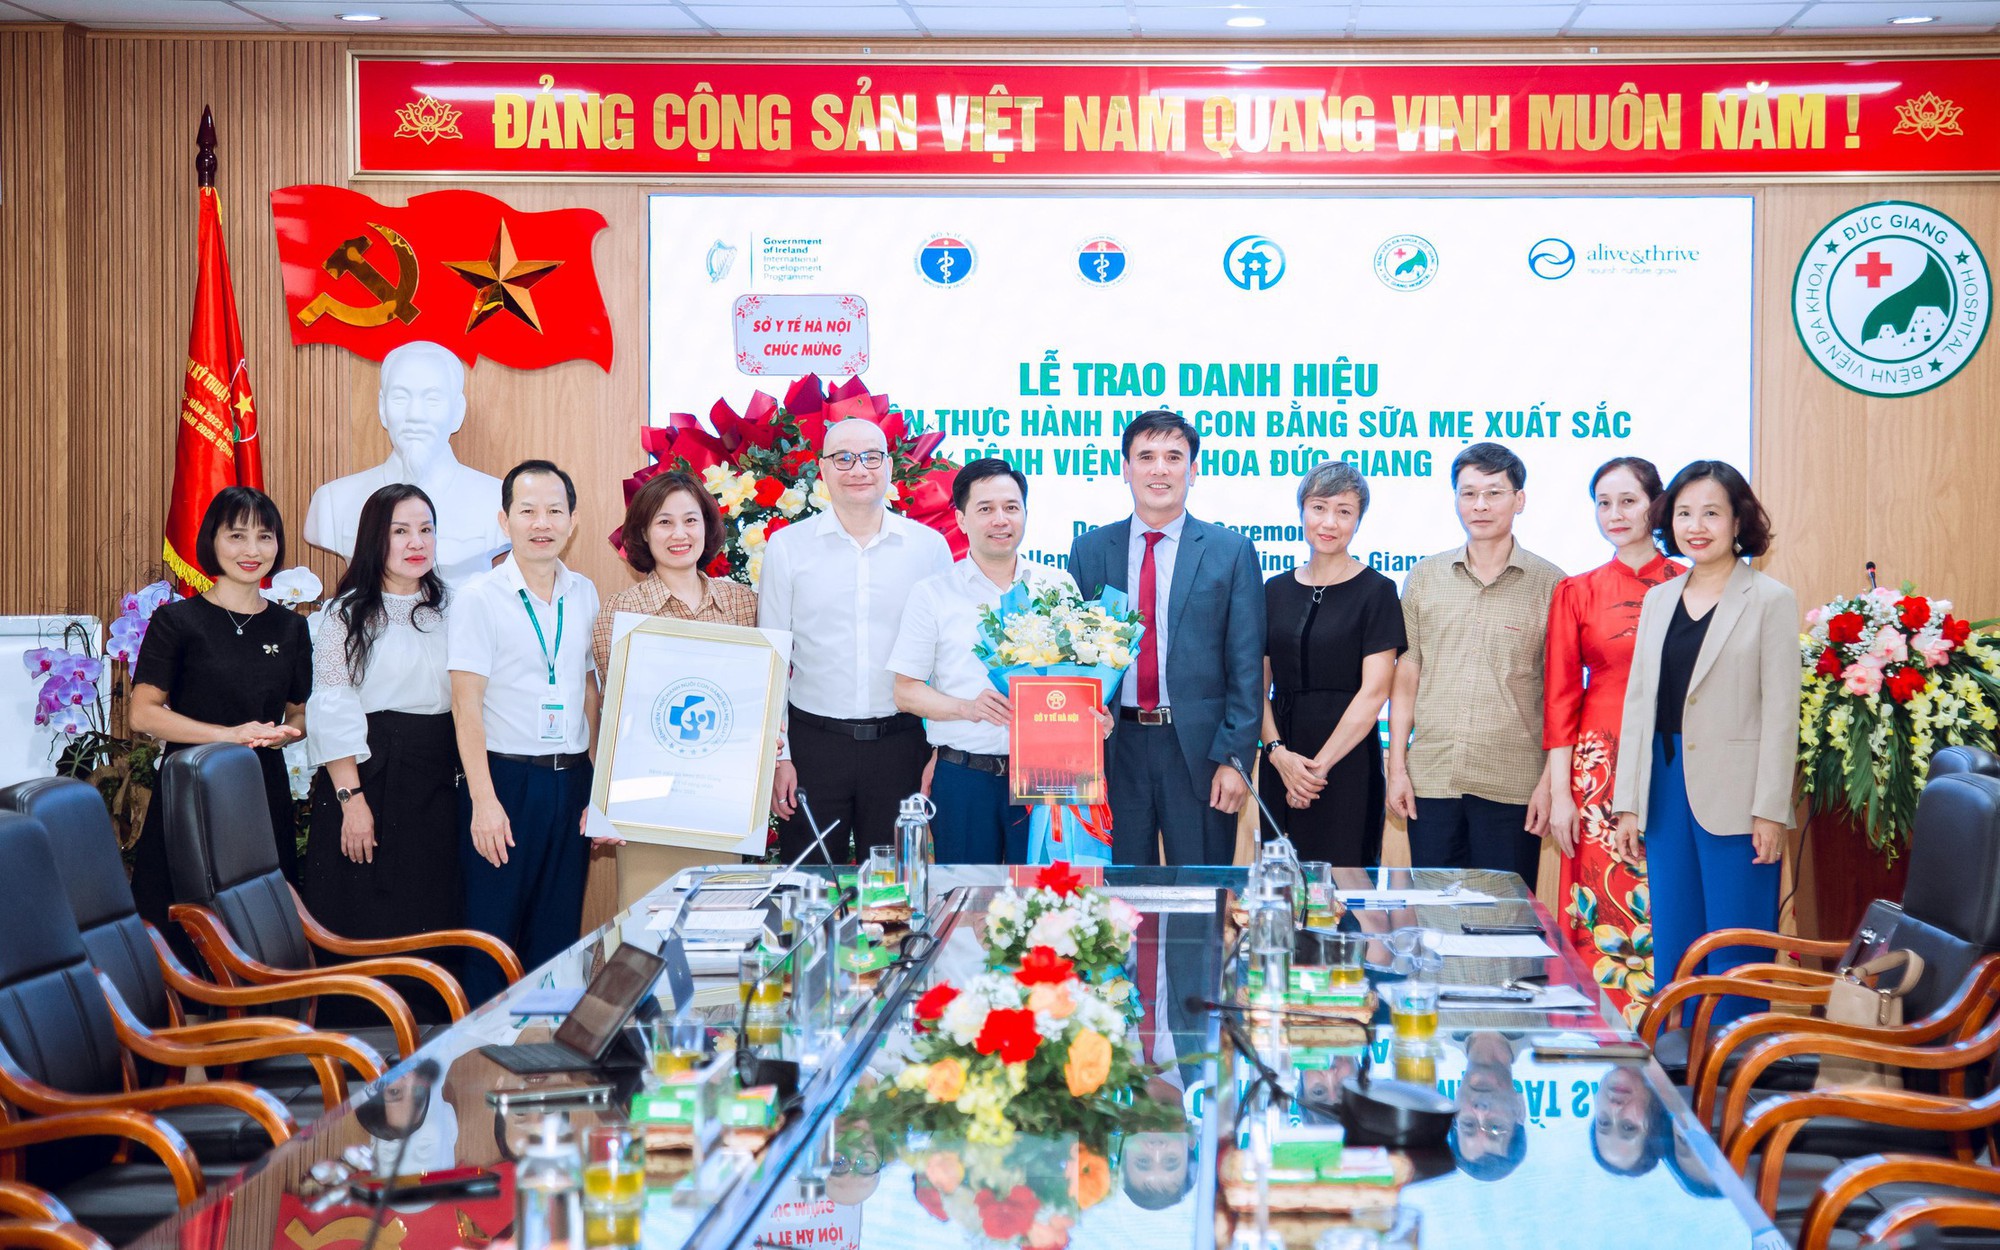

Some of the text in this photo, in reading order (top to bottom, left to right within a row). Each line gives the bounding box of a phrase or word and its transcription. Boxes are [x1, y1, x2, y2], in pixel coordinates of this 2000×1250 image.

[492, 74, 1861, 163] ĐẢNG CỘNG SẢN VIỆT NAM QUANG VINH MUÔN NĂM !
[763, 237, 822, 245] Government
[763, 246, 809, 254] of Ireland
[1587, 243, 1700, 264] alive&thrive
[763, 264, 822, 273] Development
[1805, 214, 1949, 385] BỆNH VIỆN ĐA KHOA ĐỨC GIANG
[1941, 269, 1979, 356] HOSPITAL
[753, 314, 851, 336] SỞ Y TẾ HÀ NỘI
[763, 340, 842, 356] CHÚC MỪNG
[202, 372, 231, 403] THUẬT
[1019, 349, 1378, 404] LỄ TRAO DANH HIỆU
[935, 407, 1010, 442] THỰC
[1021, 404, 1101, 436] HÀNH
[1195, 410, 1256, 437] CON
[1267, 400, 1348, 438] BẰNG
[1358, 405, 1418, 438] SỮA
[1429, 411, 1473, 443] MẸ
[1484, 401, 1561, 438] XUẤT
[1572, 400, 1631, 438] SẮC
[1053, 444, 1120, 482] VIỆN
[1197, 449, 1260, 476] HOA
[1368, 551, 1426, 571] Gian
